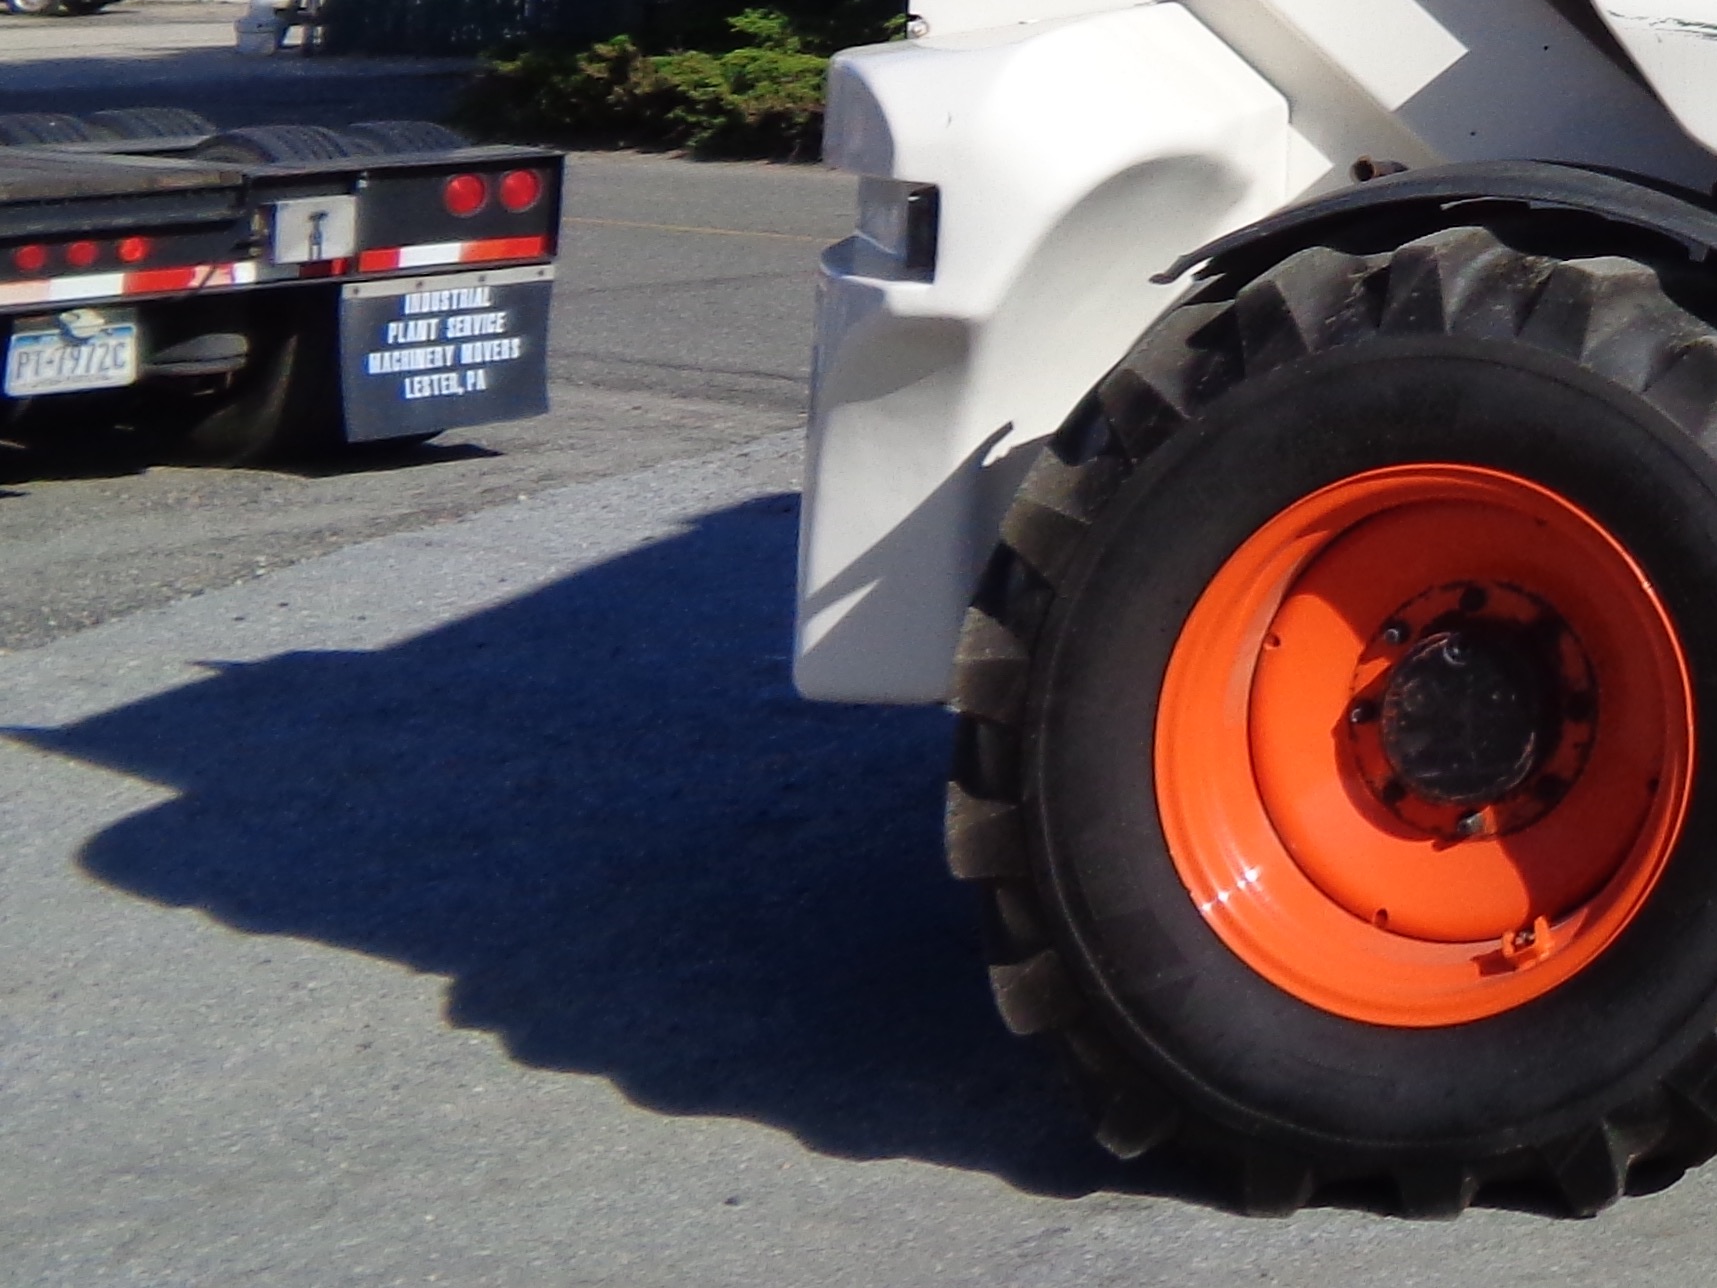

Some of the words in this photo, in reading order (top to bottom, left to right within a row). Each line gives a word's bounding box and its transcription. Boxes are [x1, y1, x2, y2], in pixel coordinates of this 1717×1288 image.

[404, 286, 492, 315] INDUSTRIAL
[387, 318, 440, 344] PLANT
[446, 311, 507, 338] SERVICE
[368, 345, 455, 374] MACHINERY
[460, 337, 522, 364] MOVERS
[405, 372, 465, 399] LESTER,
[466, 368, 487, 391] PA
